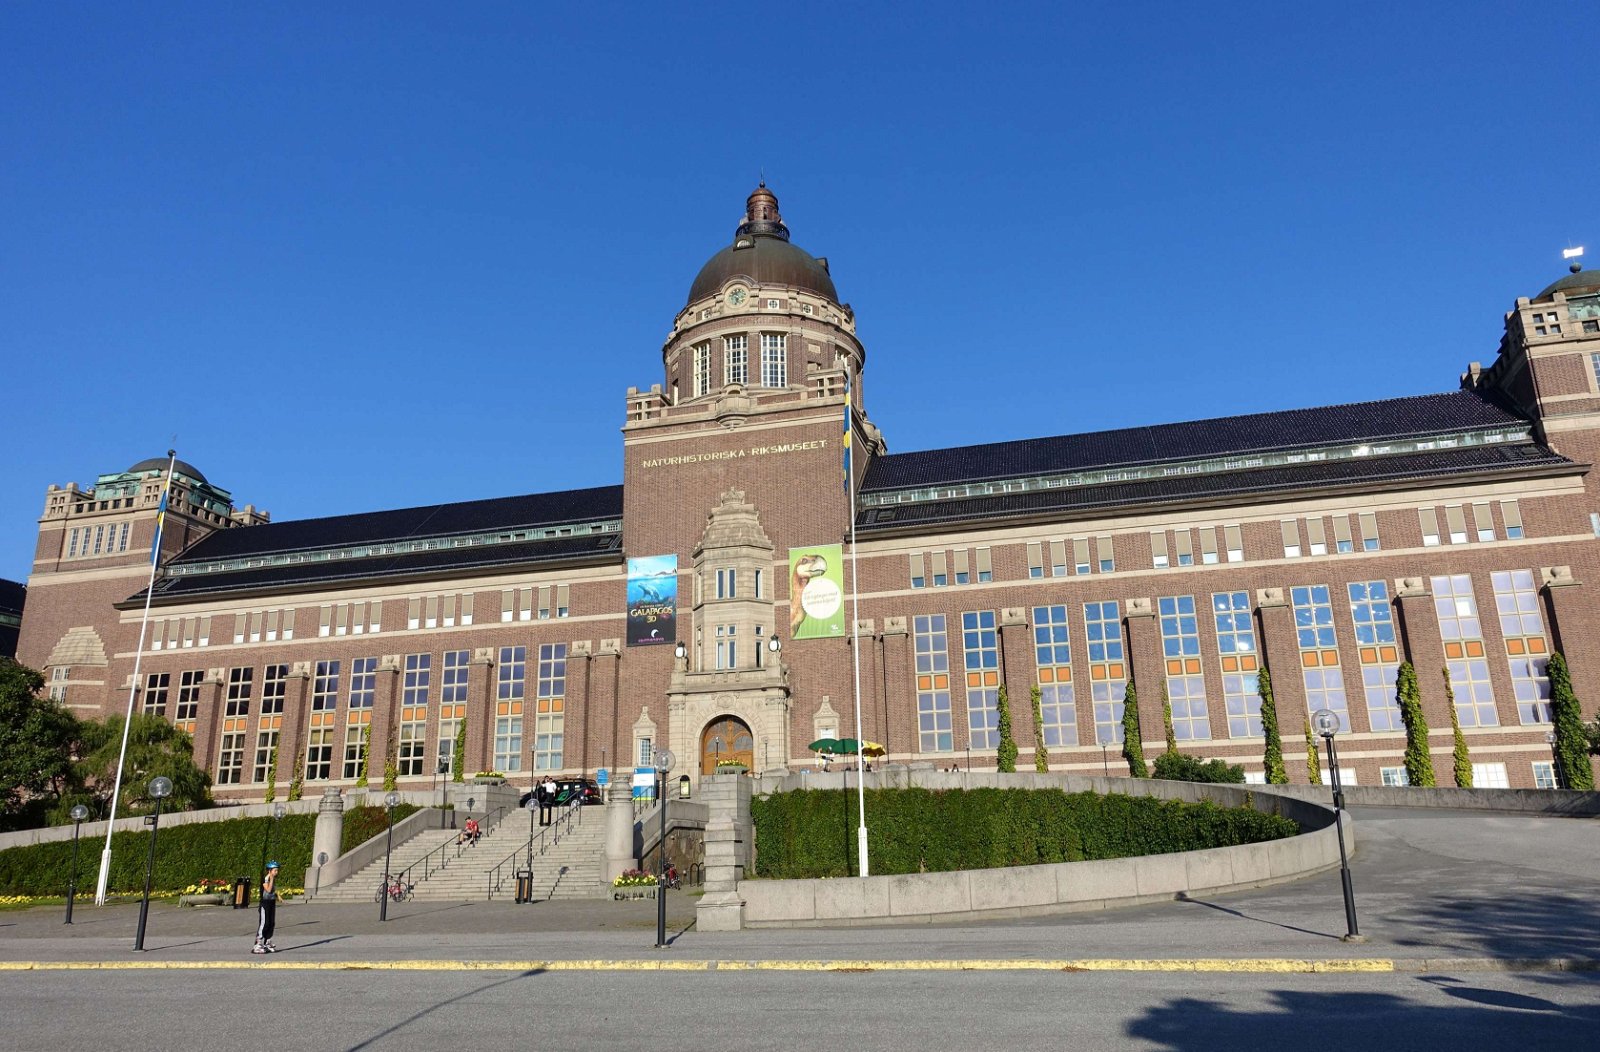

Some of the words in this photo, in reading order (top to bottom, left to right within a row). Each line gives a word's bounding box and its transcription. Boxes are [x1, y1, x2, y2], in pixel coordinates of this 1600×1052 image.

[643, 449, 746, 468] NATURHISTORISKA
[751, 439, 827, 456] RIKSMUSEET
[630, 605, 673, 617] GALAPAGOS
[646, 615, 657, 623] 3D
